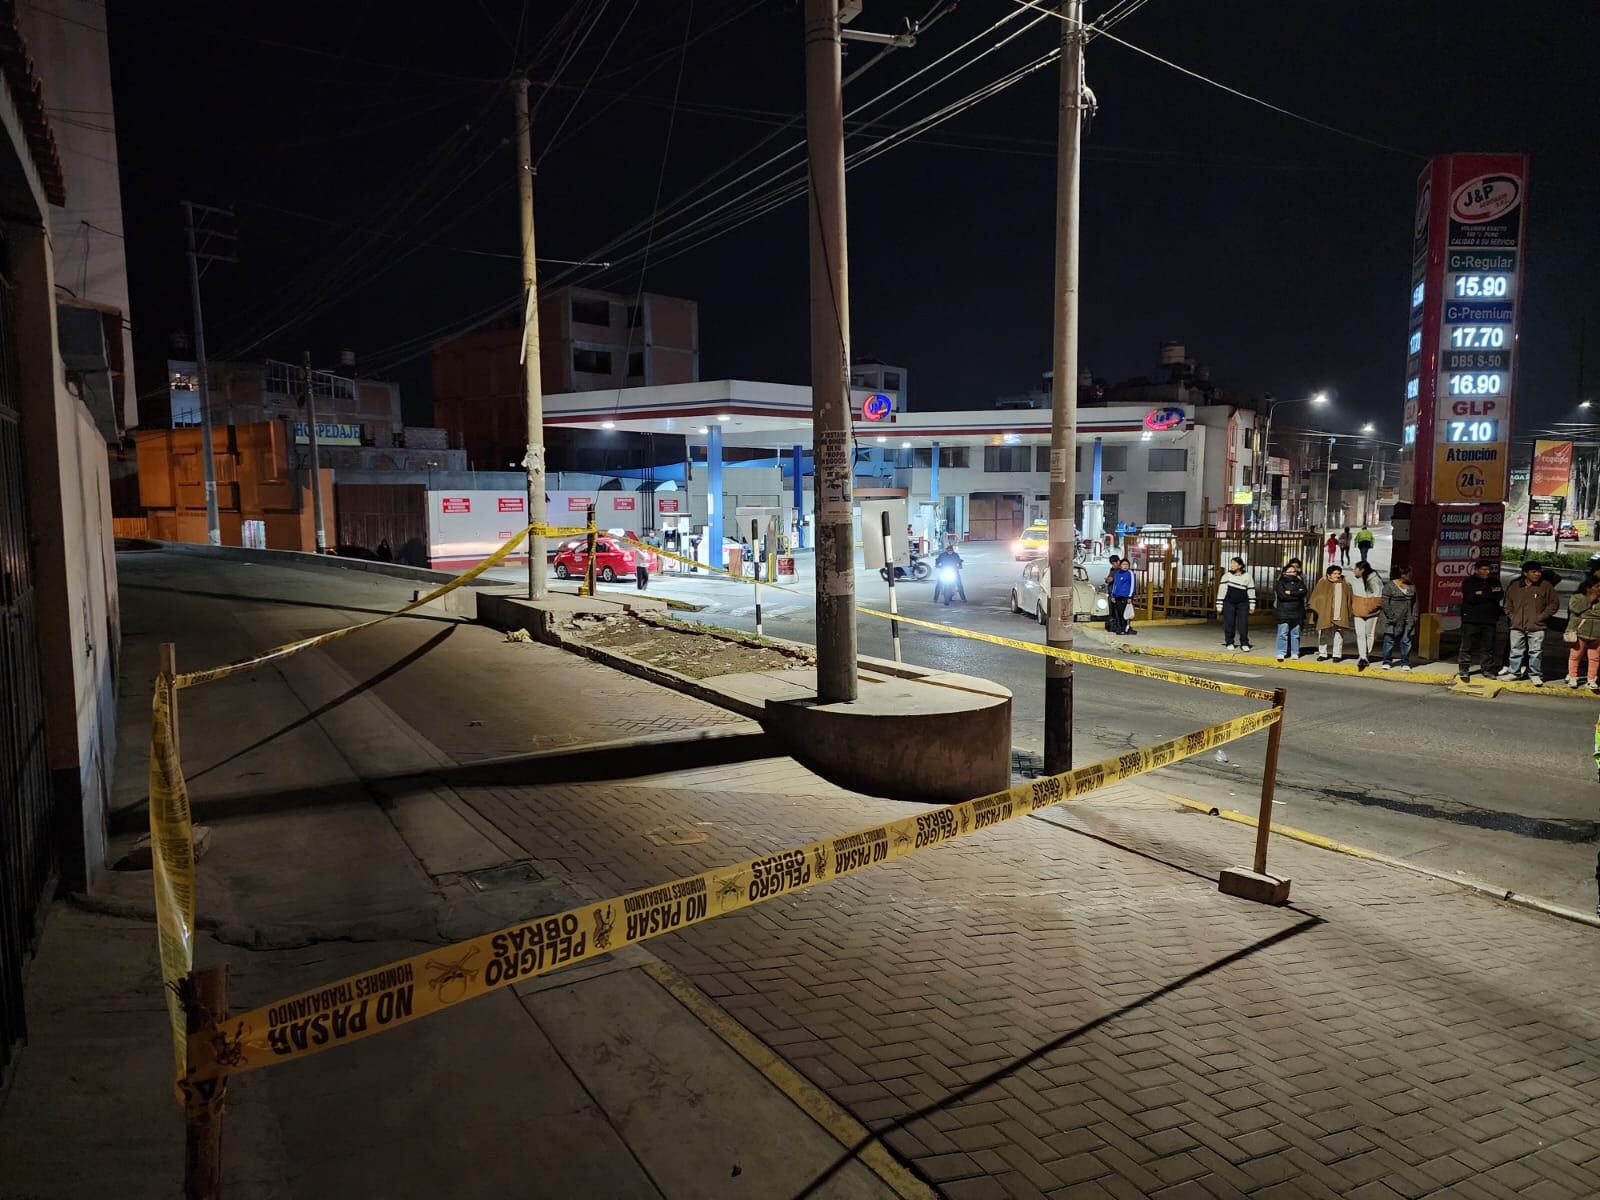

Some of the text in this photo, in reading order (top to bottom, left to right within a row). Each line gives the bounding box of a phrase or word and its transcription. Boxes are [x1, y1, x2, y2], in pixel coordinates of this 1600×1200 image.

[1464, 185, 1494, 207] J&P
[1451, 255, 1513, 270] G-Regular
[1456, 276, 1507, 296] 15.90
[1447, 307, 1512, 320] G-Premium
[1453, 327, 1504, 347] 17.70
[1451, 355, 1502, 367] DB5 S-50
[1450, 374, 1501, 394] 16.90
[1452, 401, 1496, 416] GLP
[296, 423, 360, 438] HOPEDAJE
[1451, 422, 1492, 442] 7.10
[1447, 448, 1497, 461] Atención
[1461, 474, 1474, 487] 24
[1443, 565, 1466, 575] GLP
[1119, 752, 1141, 768] OBRAS
[1032, 778, 1060, 796] OBRAS
[1032, 788, 1064, 810] PELIGRO
[916, 809, 954, 831] OBRAS
[975, 807, 1000, 830] PASAR
[1002, 802, 1013, 821] NO
[915, 821, 959, 849] PELIGRO
[751, 849, 806, 880] OBRAS
[835, 840, 888, 874] NO PASAR
[749, 863, 810, 901] PELIGRO
[624, 877, 706, 914] HOMBRES TRABAJANDO
[626, 893, 708, 941] NO PASAR
[491, 914, 578, 958] OBRAS
[485, 932, 586, 987] PELIGRO
[268, 962, 414, 1028] HOMBRES TRABAJANDO
[268, 984, 414, 1056] NO PASAR
